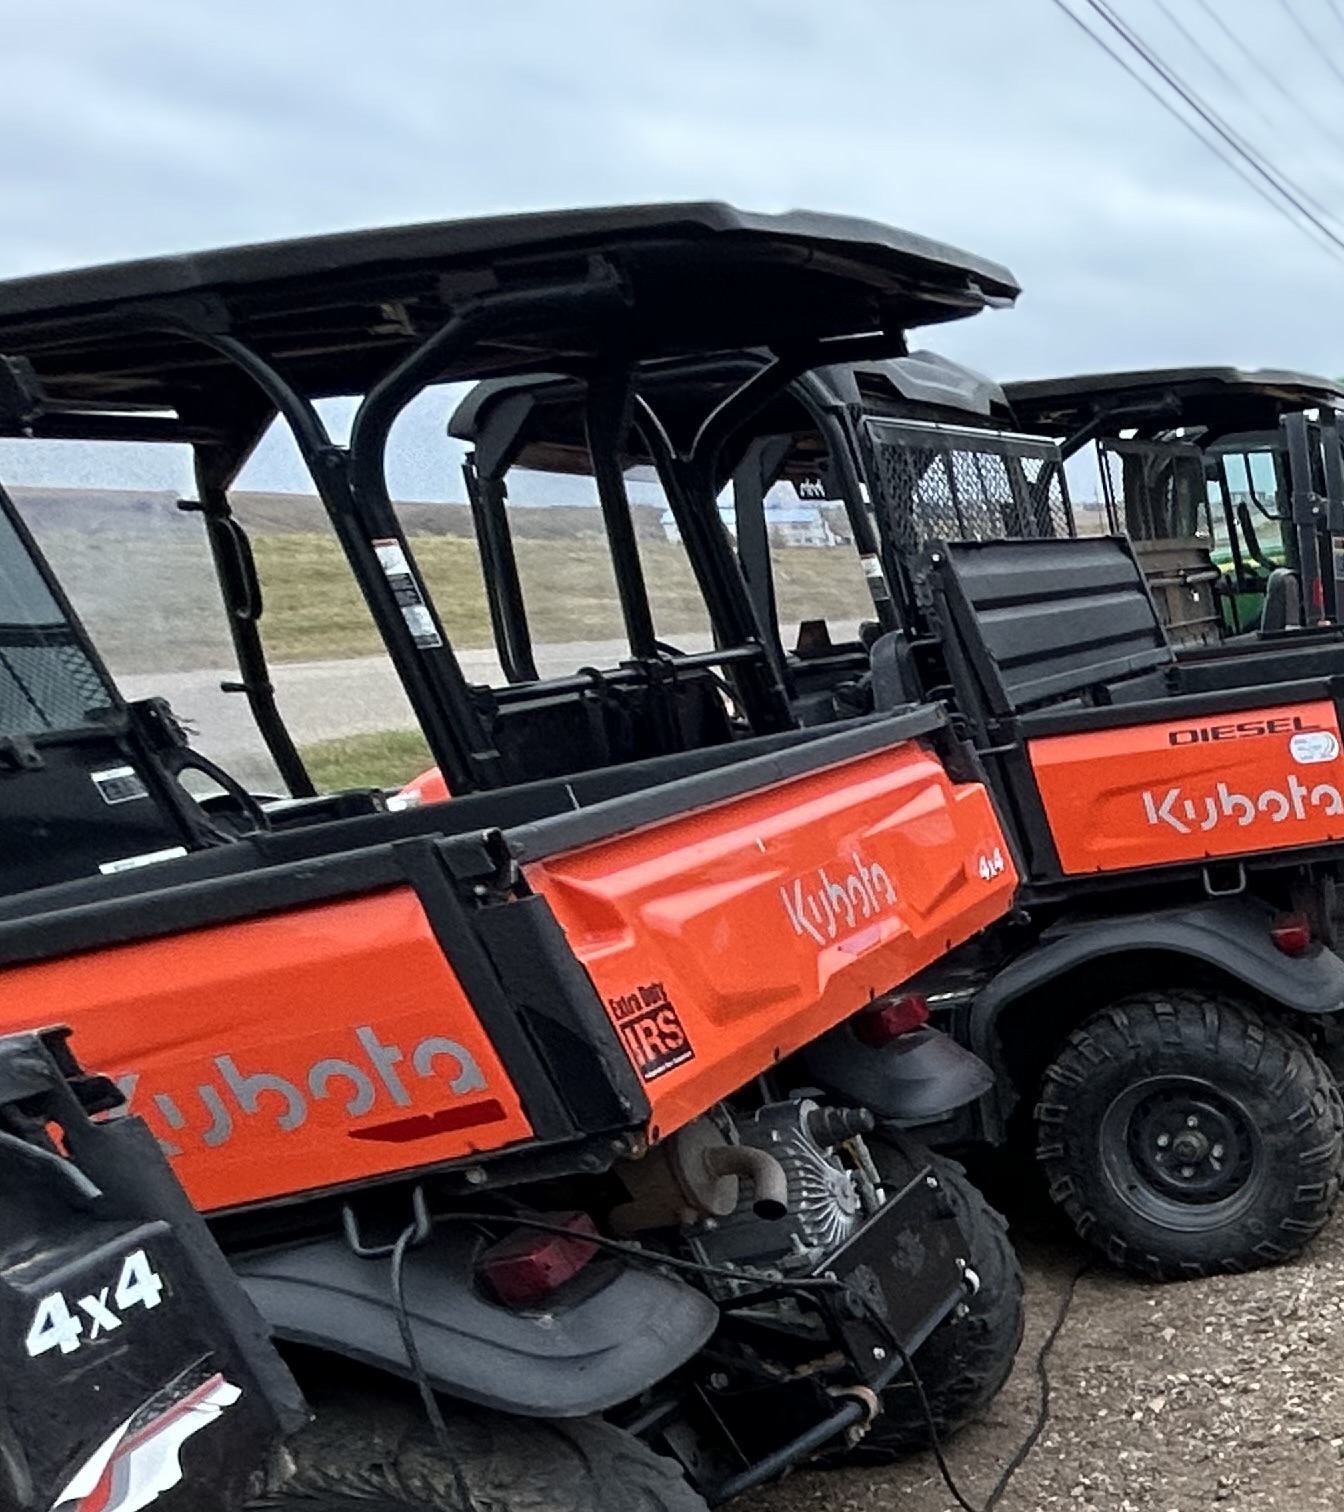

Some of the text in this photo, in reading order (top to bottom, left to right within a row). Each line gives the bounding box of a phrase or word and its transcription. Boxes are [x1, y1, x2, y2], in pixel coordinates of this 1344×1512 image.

[1169, 716, 1321, 746] DIESEL
[1142, 774, 1344, 834] Kubota
[979, 847, 1005, 881] 4x4
[780, 852, 898, 946] Kubota
[624, 1009, 684, 1068] IRS
[107, 1025, 488, 1157] ubota
[26, 1249, 163, 1357] 4x4
